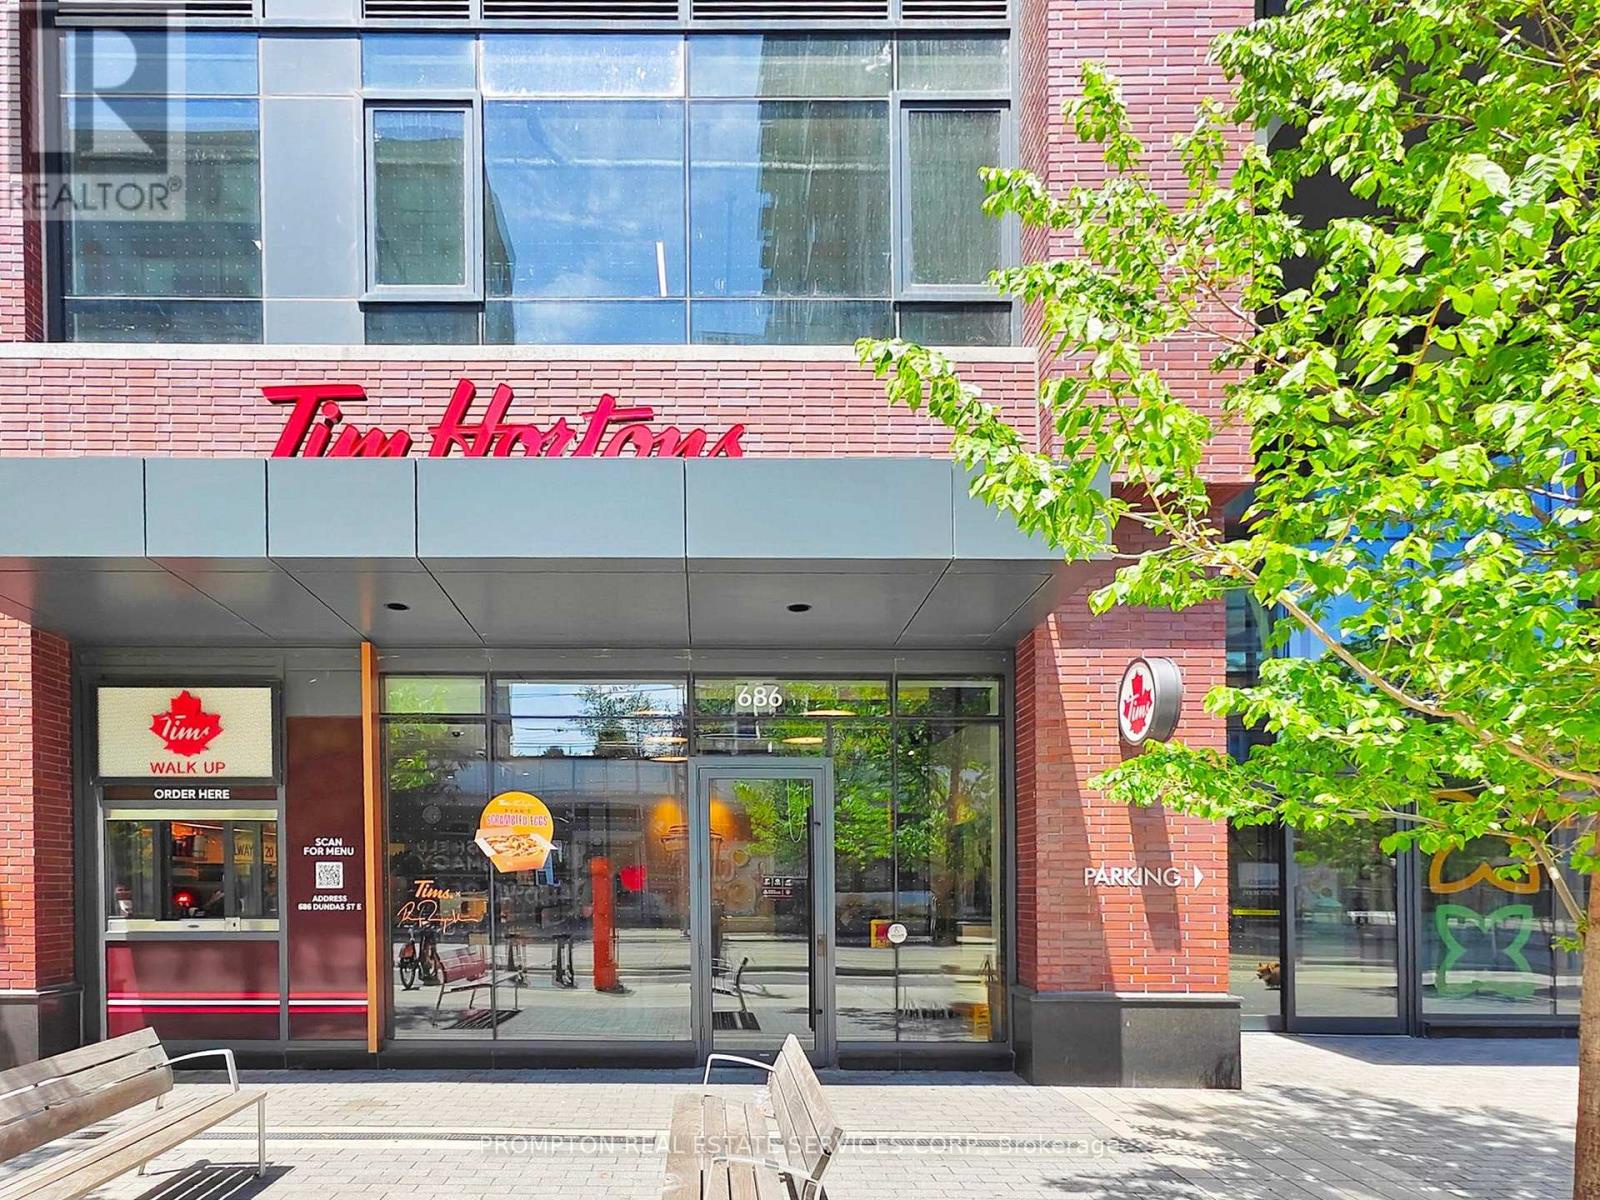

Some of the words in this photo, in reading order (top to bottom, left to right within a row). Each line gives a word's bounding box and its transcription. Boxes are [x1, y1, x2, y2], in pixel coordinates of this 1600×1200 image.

[261, 383, 414, 458] Tim
[428, 378, 745, 458] Hortons
[738, 686, 782, 707] 686
[1123, 693, 1151, 723] Tims
[158, 715, 210, 741] Tims
[150, 762, 196, 774] WALK
[203, 762, 226, 774] UP
[153, 789, 196, 799] ORDER
[199, 789, 230, 799] HERE
[488, 812, 528, 826] SCRAMBLED
[530, 814, 548, 827] EGGS
[315, 838, 342, 847] SCAN
[303, 847, 324, 856] FOR
[325, 847, 354, 856] MENU
[1084, 867, 1182, 887] PARKING
[298, 903, 312, 911] 686
[313, 903, 345, 911] DUNDAS
[346, 903, 355, 911] ST
[356, 903, 362, 911] E
